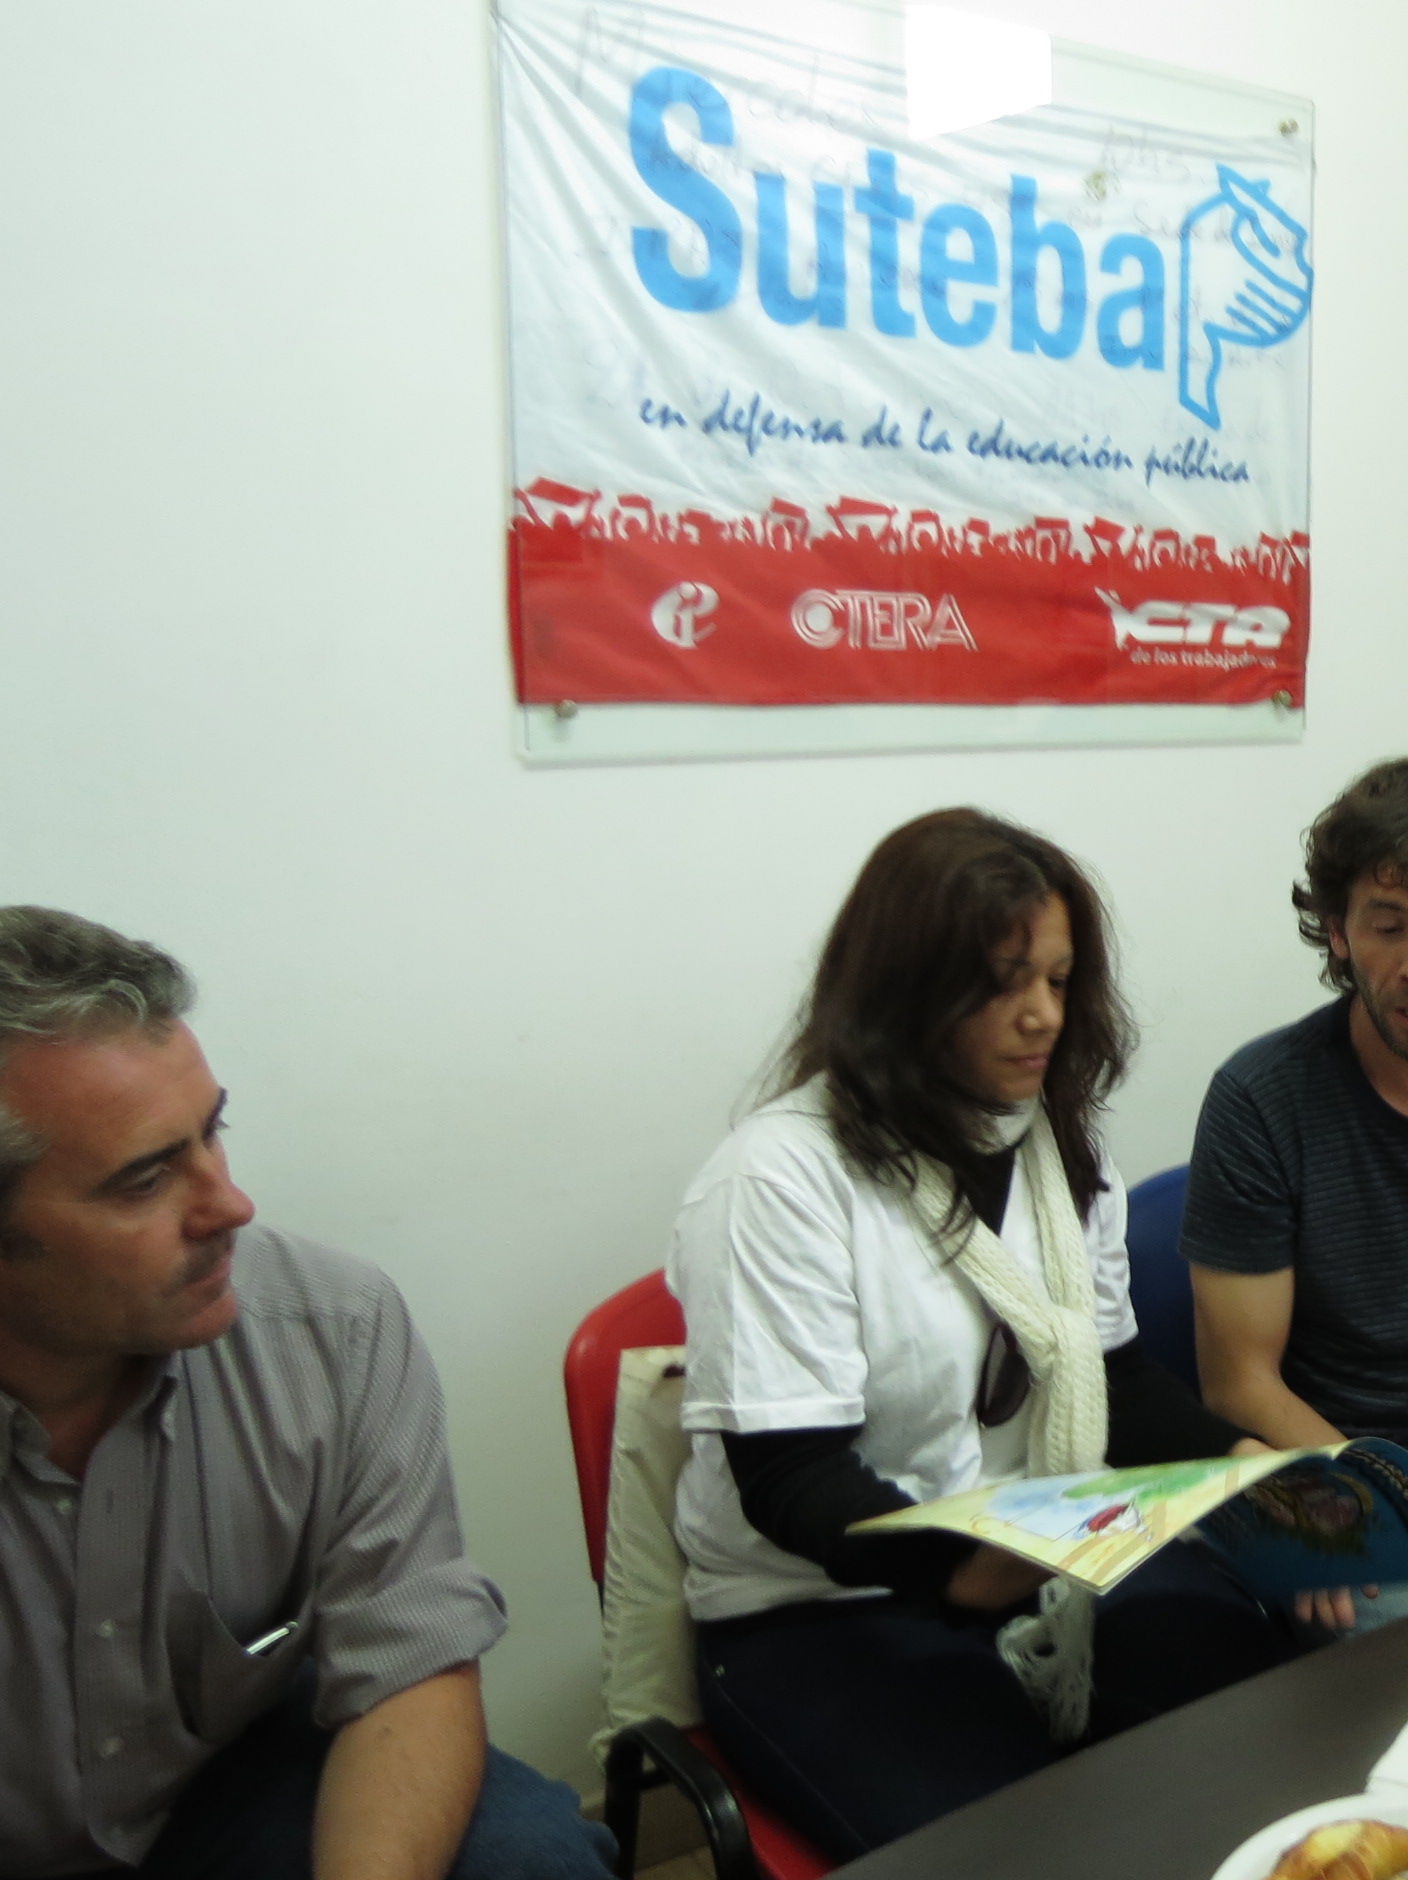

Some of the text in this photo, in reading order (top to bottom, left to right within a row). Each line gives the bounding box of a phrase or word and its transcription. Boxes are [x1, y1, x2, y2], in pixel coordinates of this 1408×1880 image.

[628, 66, 1166, 372] Suteba
[639, 387, 1250, 488] en defensa de la educación pública
[790, 588, 979, 651] CTERA
